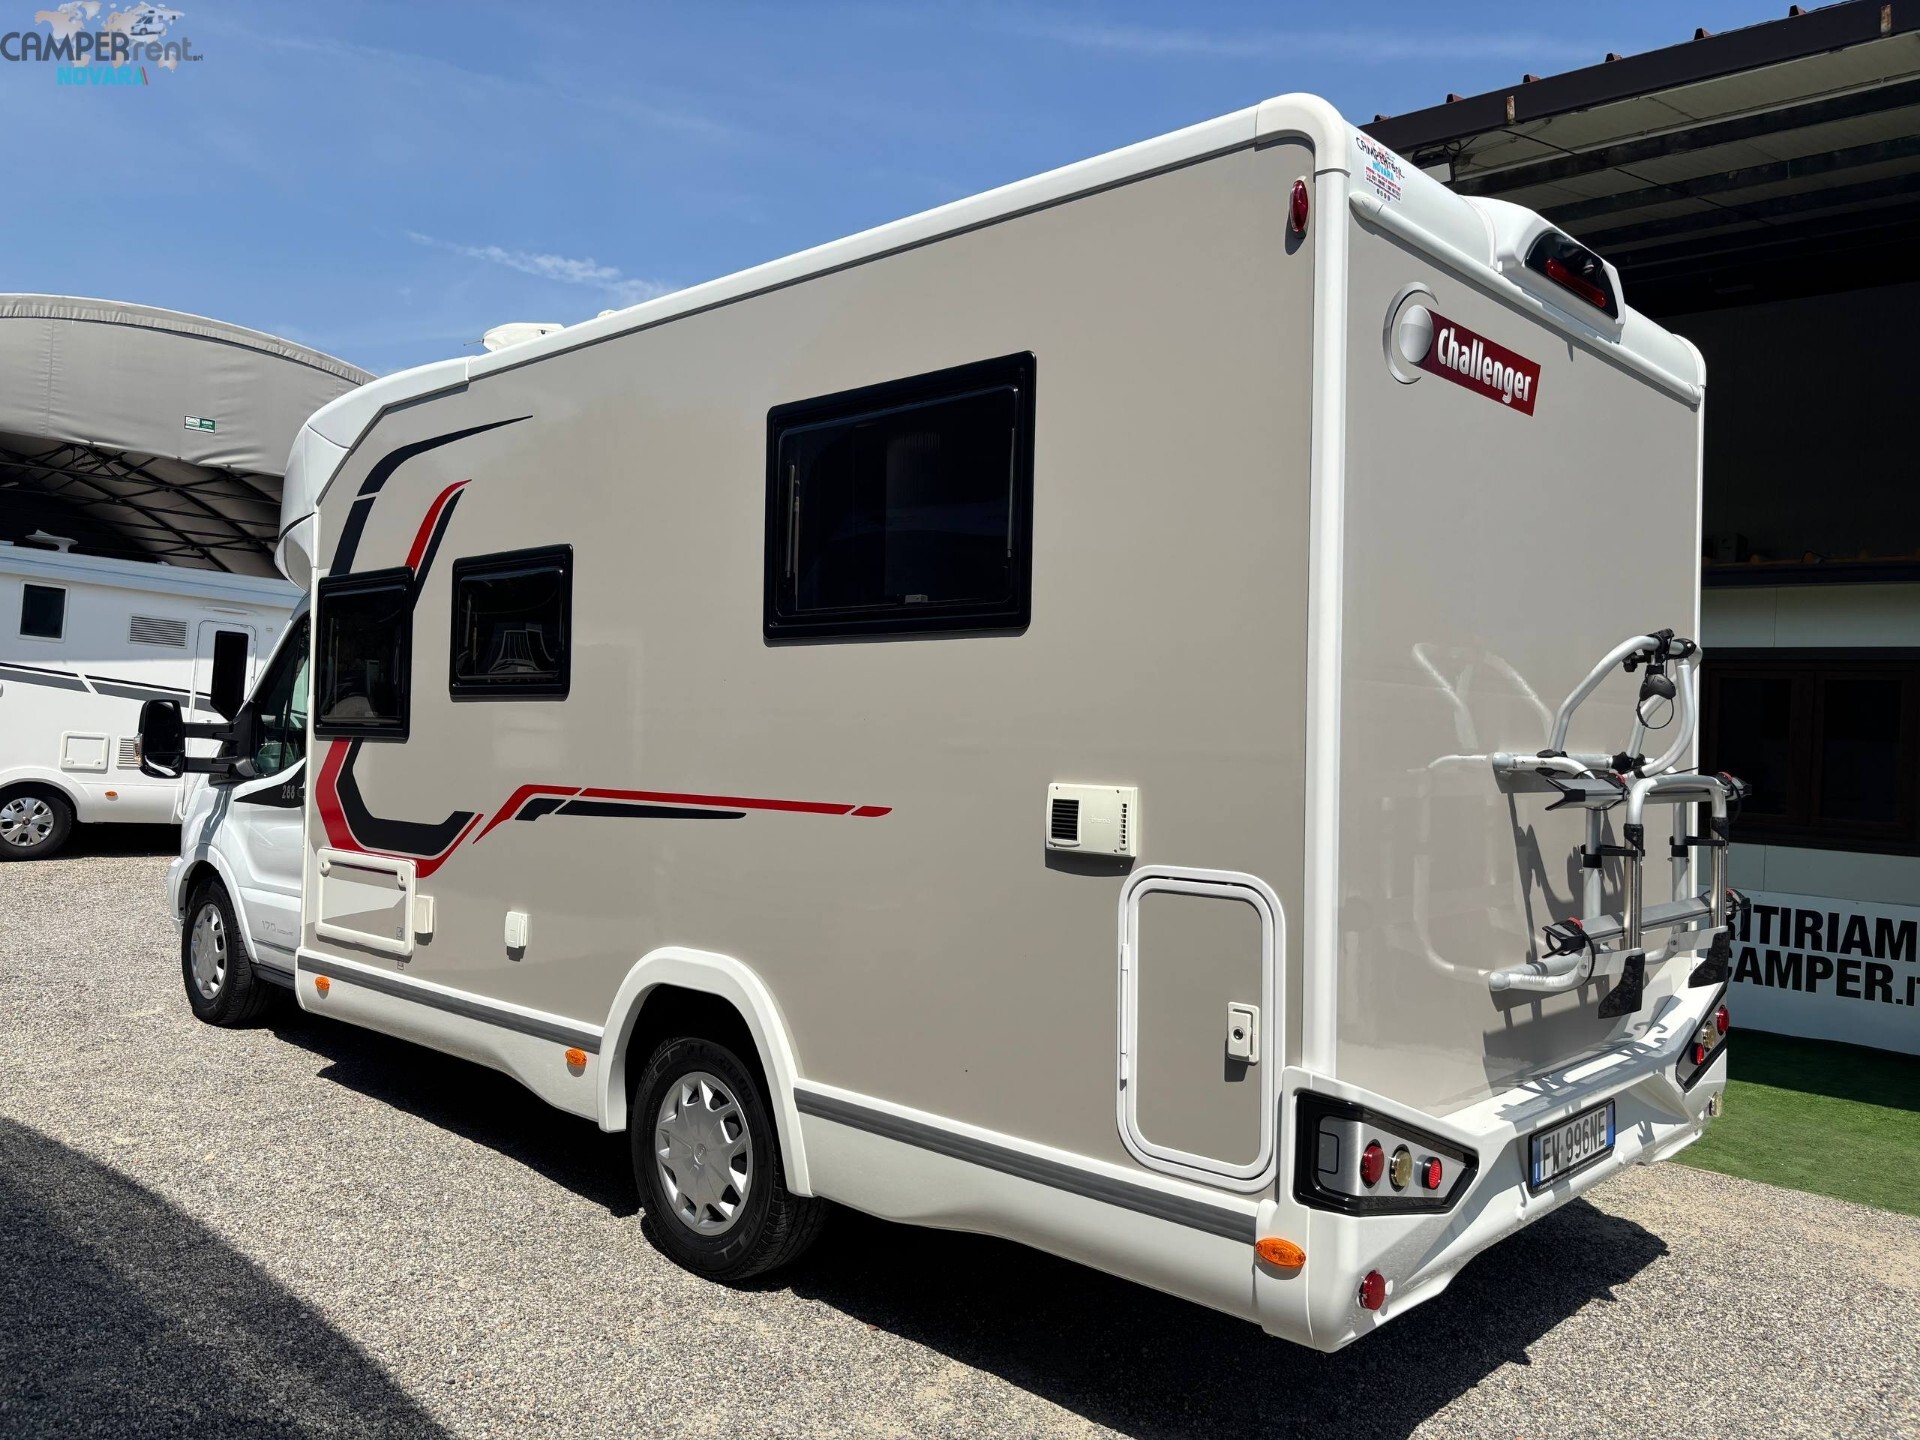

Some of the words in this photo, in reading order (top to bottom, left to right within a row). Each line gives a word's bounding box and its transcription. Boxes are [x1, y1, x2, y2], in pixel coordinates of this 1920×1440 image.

[1437, 327, 1531, 404] Challenger
[1726, 903, 1917, 963] ITIRIAM
[1728, 946, 1920, 1006] AMPER.I
